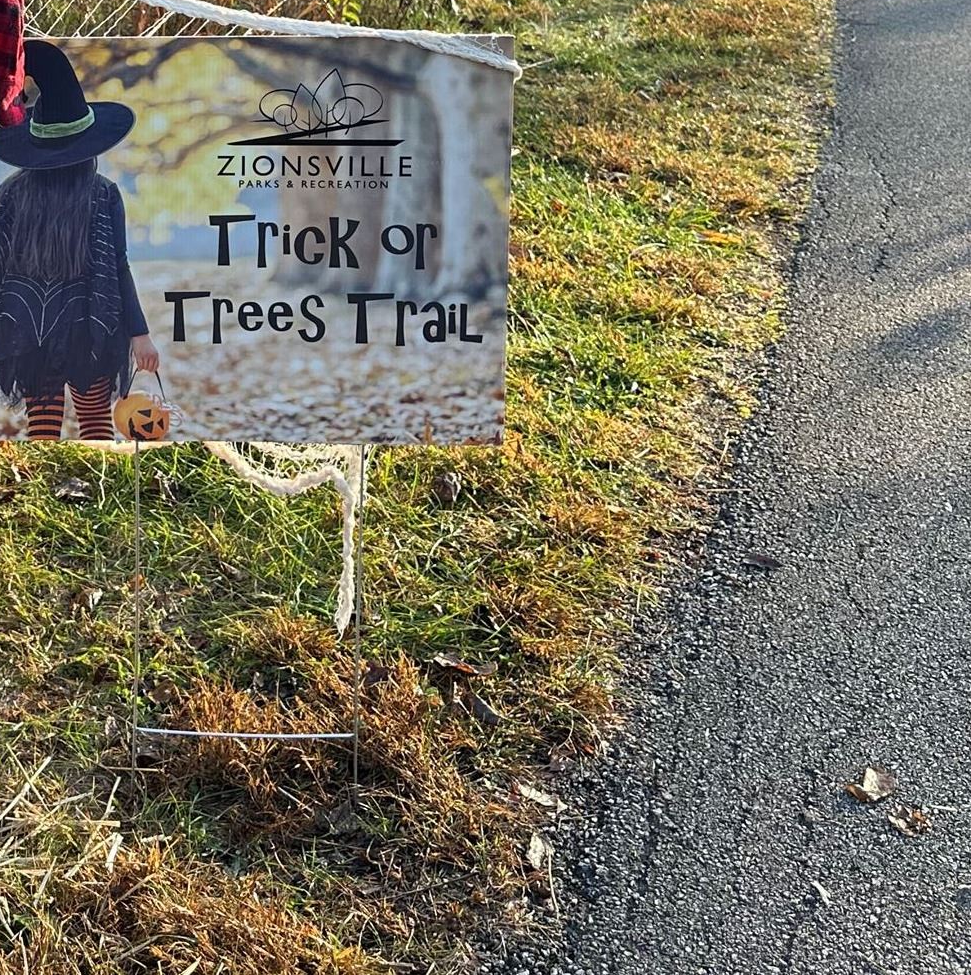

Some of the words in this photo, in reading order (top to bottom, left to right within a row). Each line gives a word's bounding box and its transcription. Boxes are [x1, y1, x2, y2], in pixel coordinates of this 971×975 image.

[217, 155, 413, 177] ZIONSVILLE
[238, 179, 280, 189] PARKS
[286, 179, 294, 189] &
[300, 179, 390, 189] RECREATION
[381, 223, 438, 270] or
